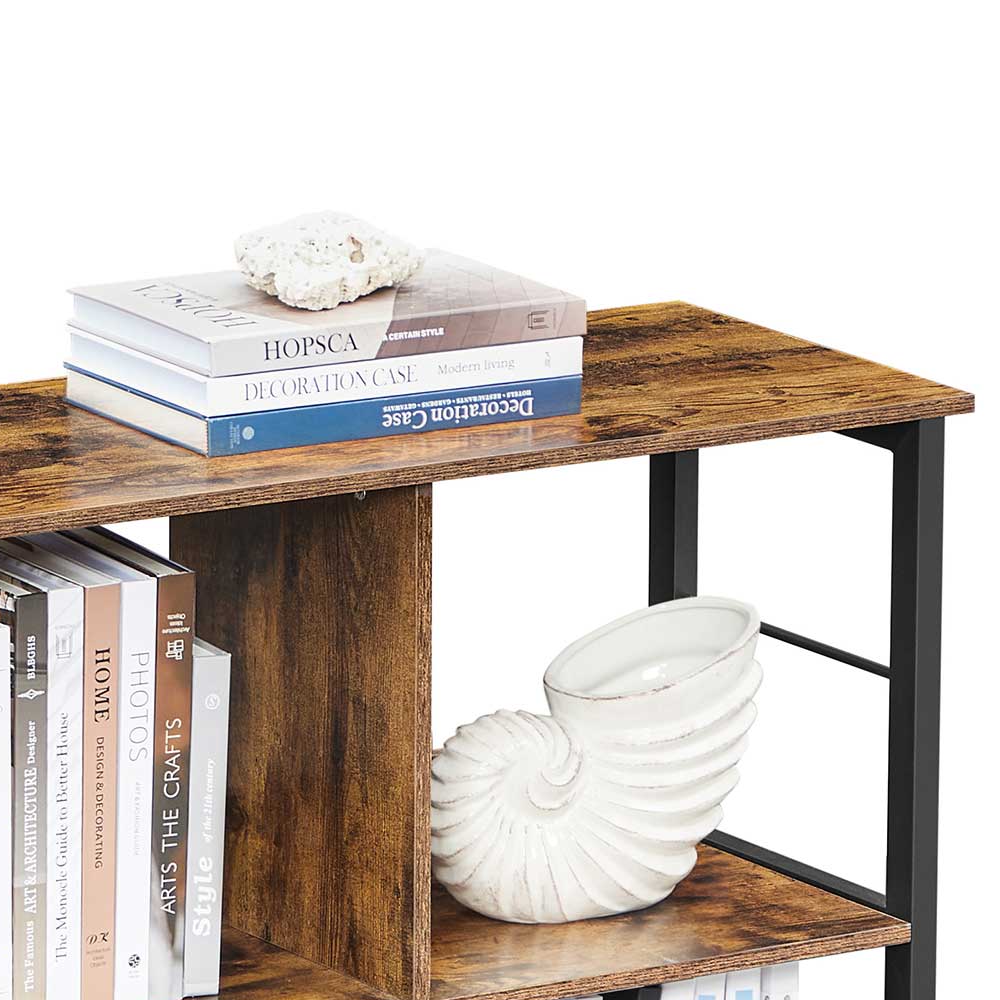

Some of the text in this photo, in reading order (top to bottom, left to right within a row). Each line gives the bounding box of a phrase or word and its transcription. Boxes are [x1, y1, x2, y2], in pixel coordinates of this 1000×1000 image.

[244, 358, 516, 401] DECORATION CASE Modern living
[264, 332, 360, 361] HOPSCA
[389, 329, 421, 341] CERTAIN
[422, 326, 445, 338] STYLE
[382, 397, 535, 430] Decoration Case
[506, 389, 532, 398] HOTELS
[128, 651, 150, 763] PHOTOS
[94, 648, 111, 870] HOME DESIGN & DECORATING
[23, 720, 38, 993] The Famous ART & ARCHITECTURE Designer
[55, 712, 70, 963] The Monocle Guide to Better House
[159, 717, 183, 915] ARTS THE CRAFTS
[192, 855, 217, 937] Style
